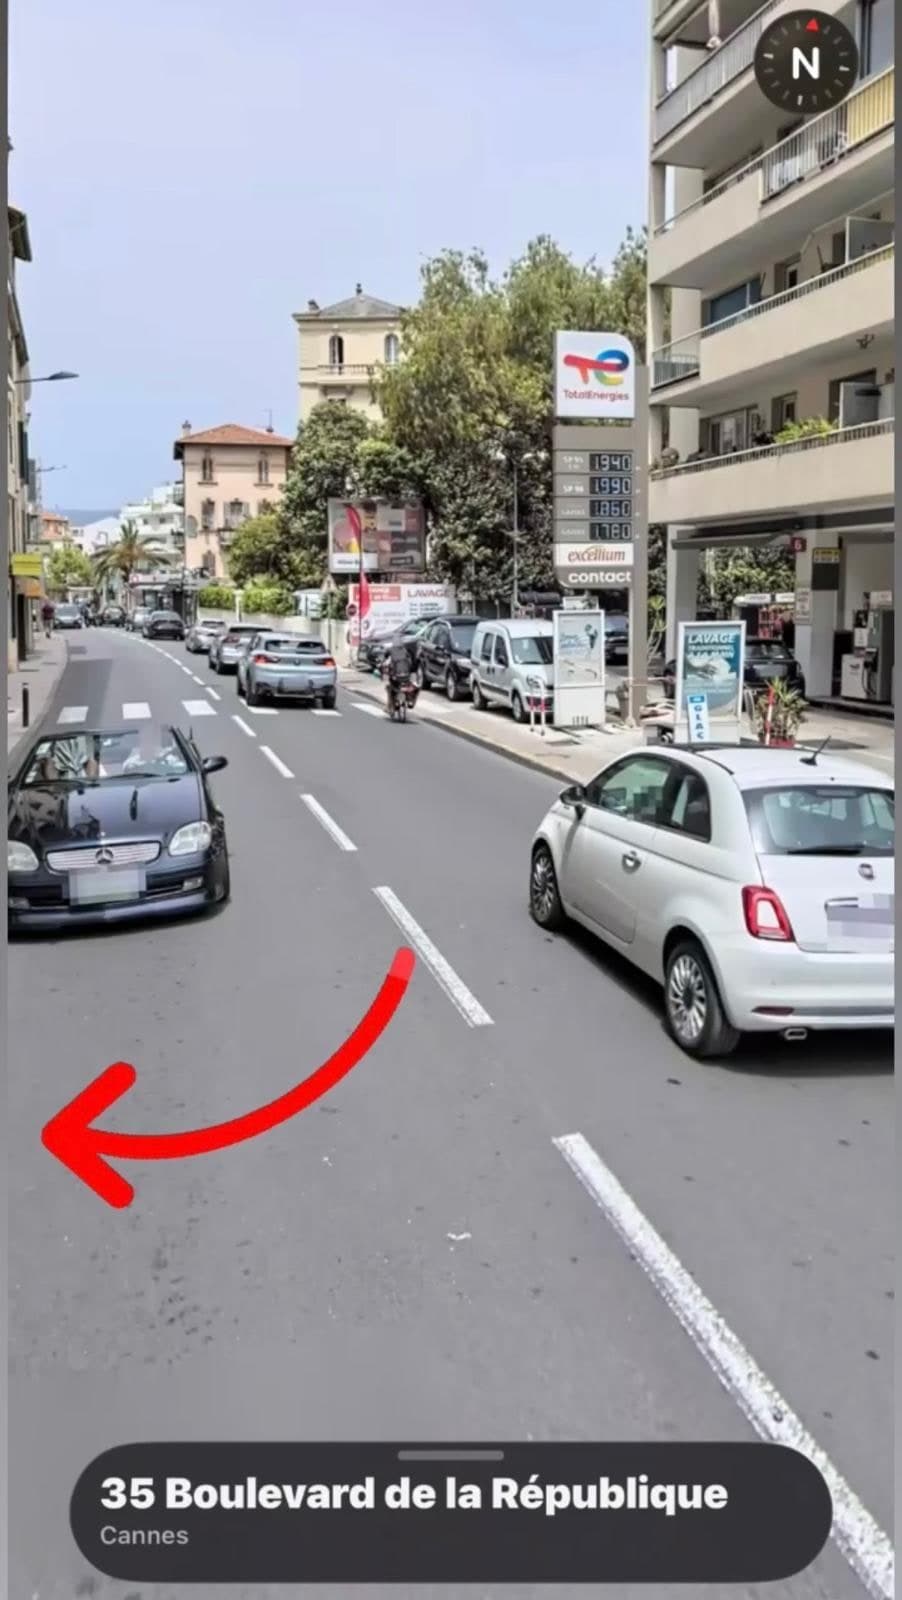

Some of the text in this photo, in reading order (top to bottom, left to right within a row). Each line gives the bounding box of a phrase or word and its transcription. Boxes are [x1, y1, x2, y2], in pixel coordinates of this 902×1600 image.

[563, 388, 629, 402] TotalEnergies
[567, 548, 625, 563] excellium
[567, 570, 632, 583] contact
[688, 633, 736, 644] LAVAGE
